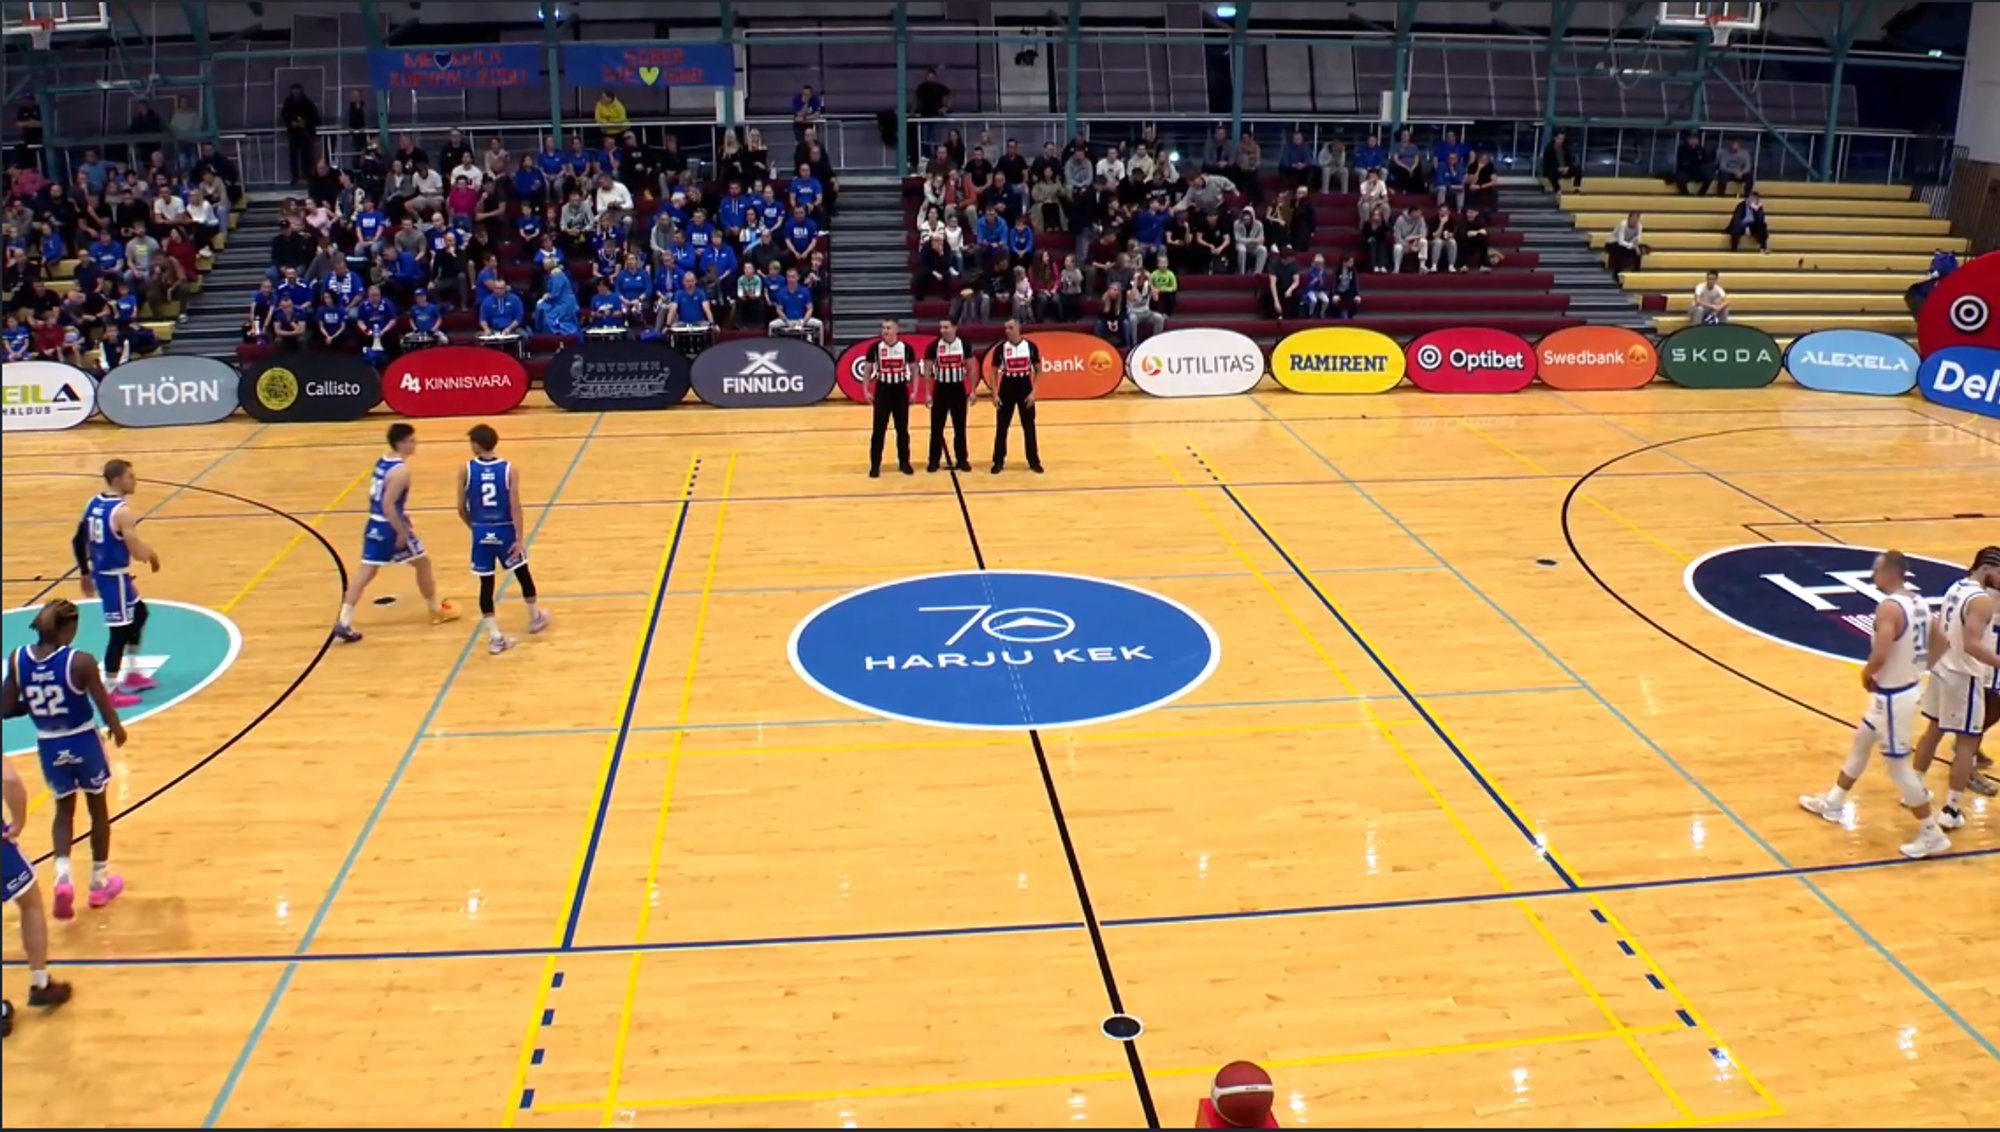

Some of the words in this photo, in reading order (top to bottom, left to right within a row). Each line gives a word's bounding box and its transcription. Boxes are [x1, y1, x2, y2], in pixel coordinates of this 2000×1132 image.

[586, 361, 662, 373] PRYDWEN
[1041, 356, 1084, 372] bank
[1167, 354, 1255, 374] UTILITAS
[1289, 353, 1388, 372] RAMIRENT
[1449, 348, 1524, 371] Optibet
[1543, 350, 1625, 366] Swedbank
[1801, 351, 1909, 372] ALEXELA
[119, 377, 219, 406] THÖRN
[306, 381, 361, 396] Callisto
[425, 374, 512, 390] KINNISVARA
[723, 375, 804, 394] FINNLOG
[1933, 360, 2000, 404] Del
[482, 482, 497, 506] 2
[866, 650, 1033, 670] HARJU
[1054, 645, 1153, 662] KEK
[26, 685, 69, 716] 22
